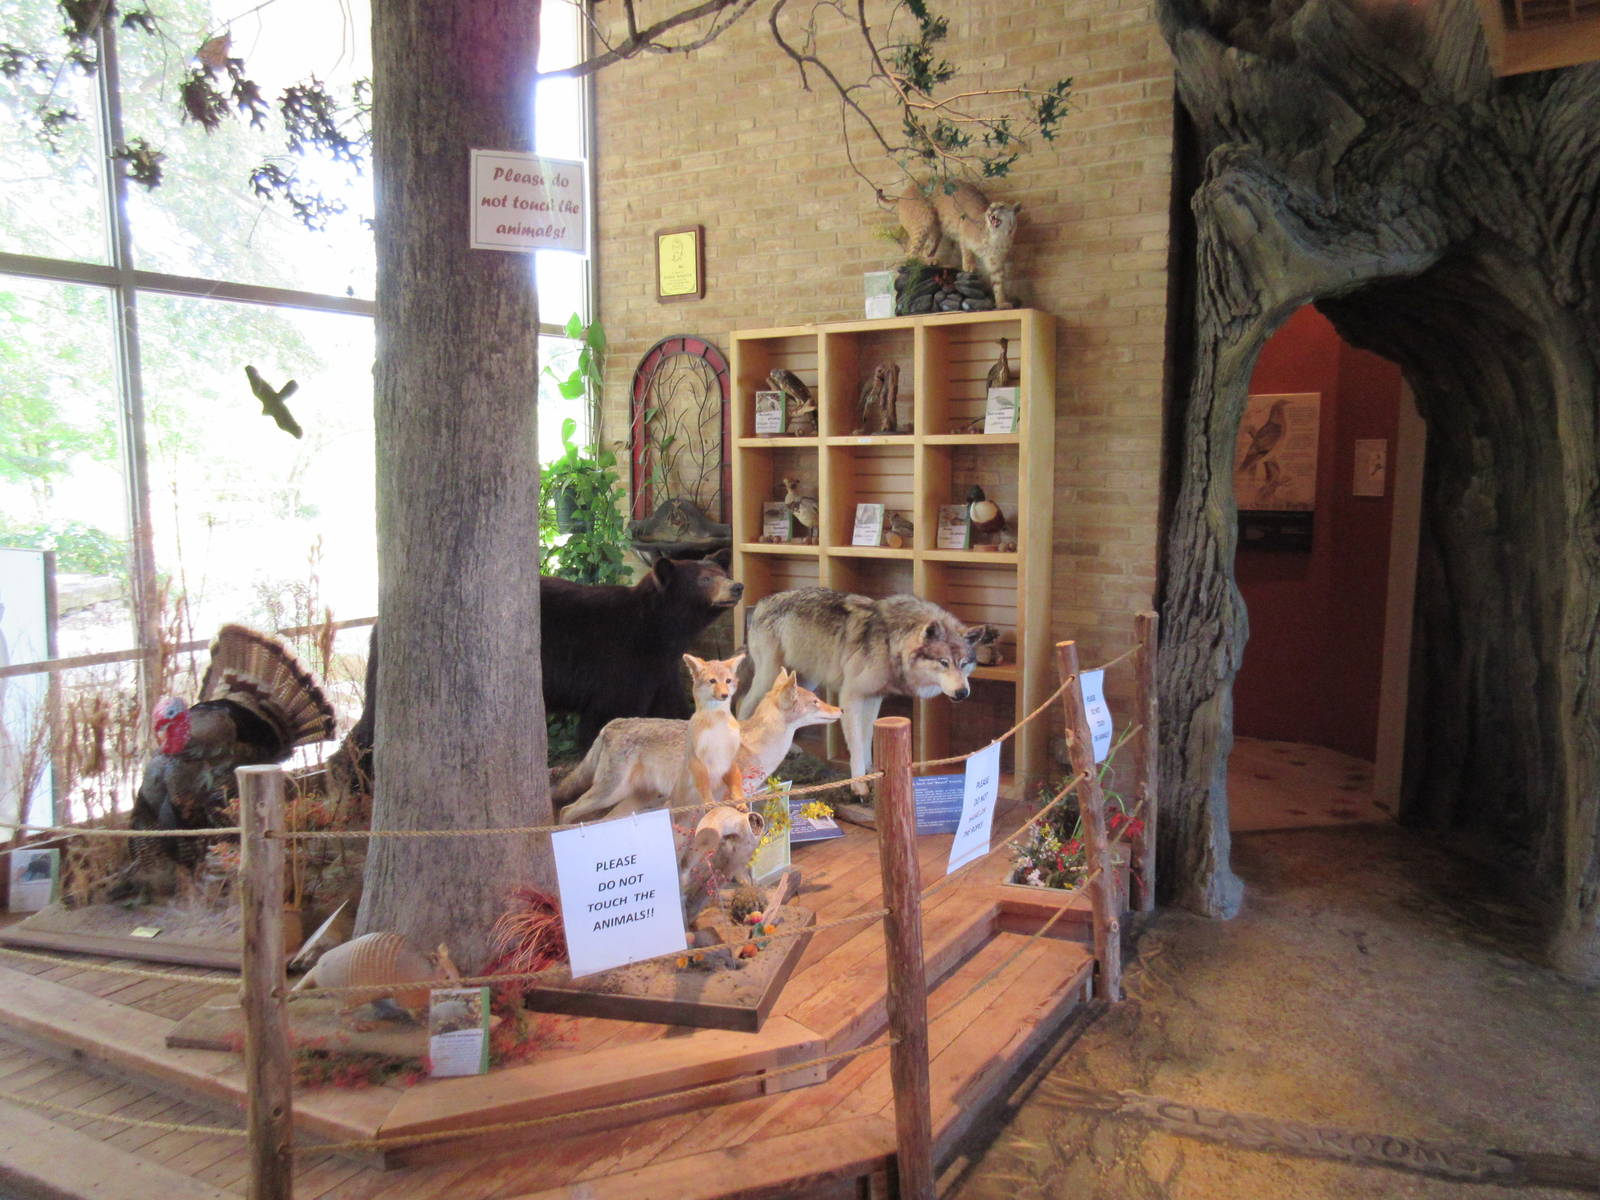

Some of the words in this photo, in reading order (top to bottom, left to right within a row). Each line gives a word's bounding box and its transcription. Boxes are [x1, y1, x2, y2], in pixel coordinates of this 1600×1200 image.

[552, 172, 569, 188] do
[481, 194, 508, 208] not
[558, 199, 580, 215] the
[496, 221, 566, 240] animals!
[596, 854, 637, 872] PLEASE
[598, 880, 616, 892] DO
[619, 874, 644, 888] NOT
[587, 896, 628, 913] TOUCH
[634, 889, 656, 903] THE
[593, 908, 655, 932] ANIMALS!!
